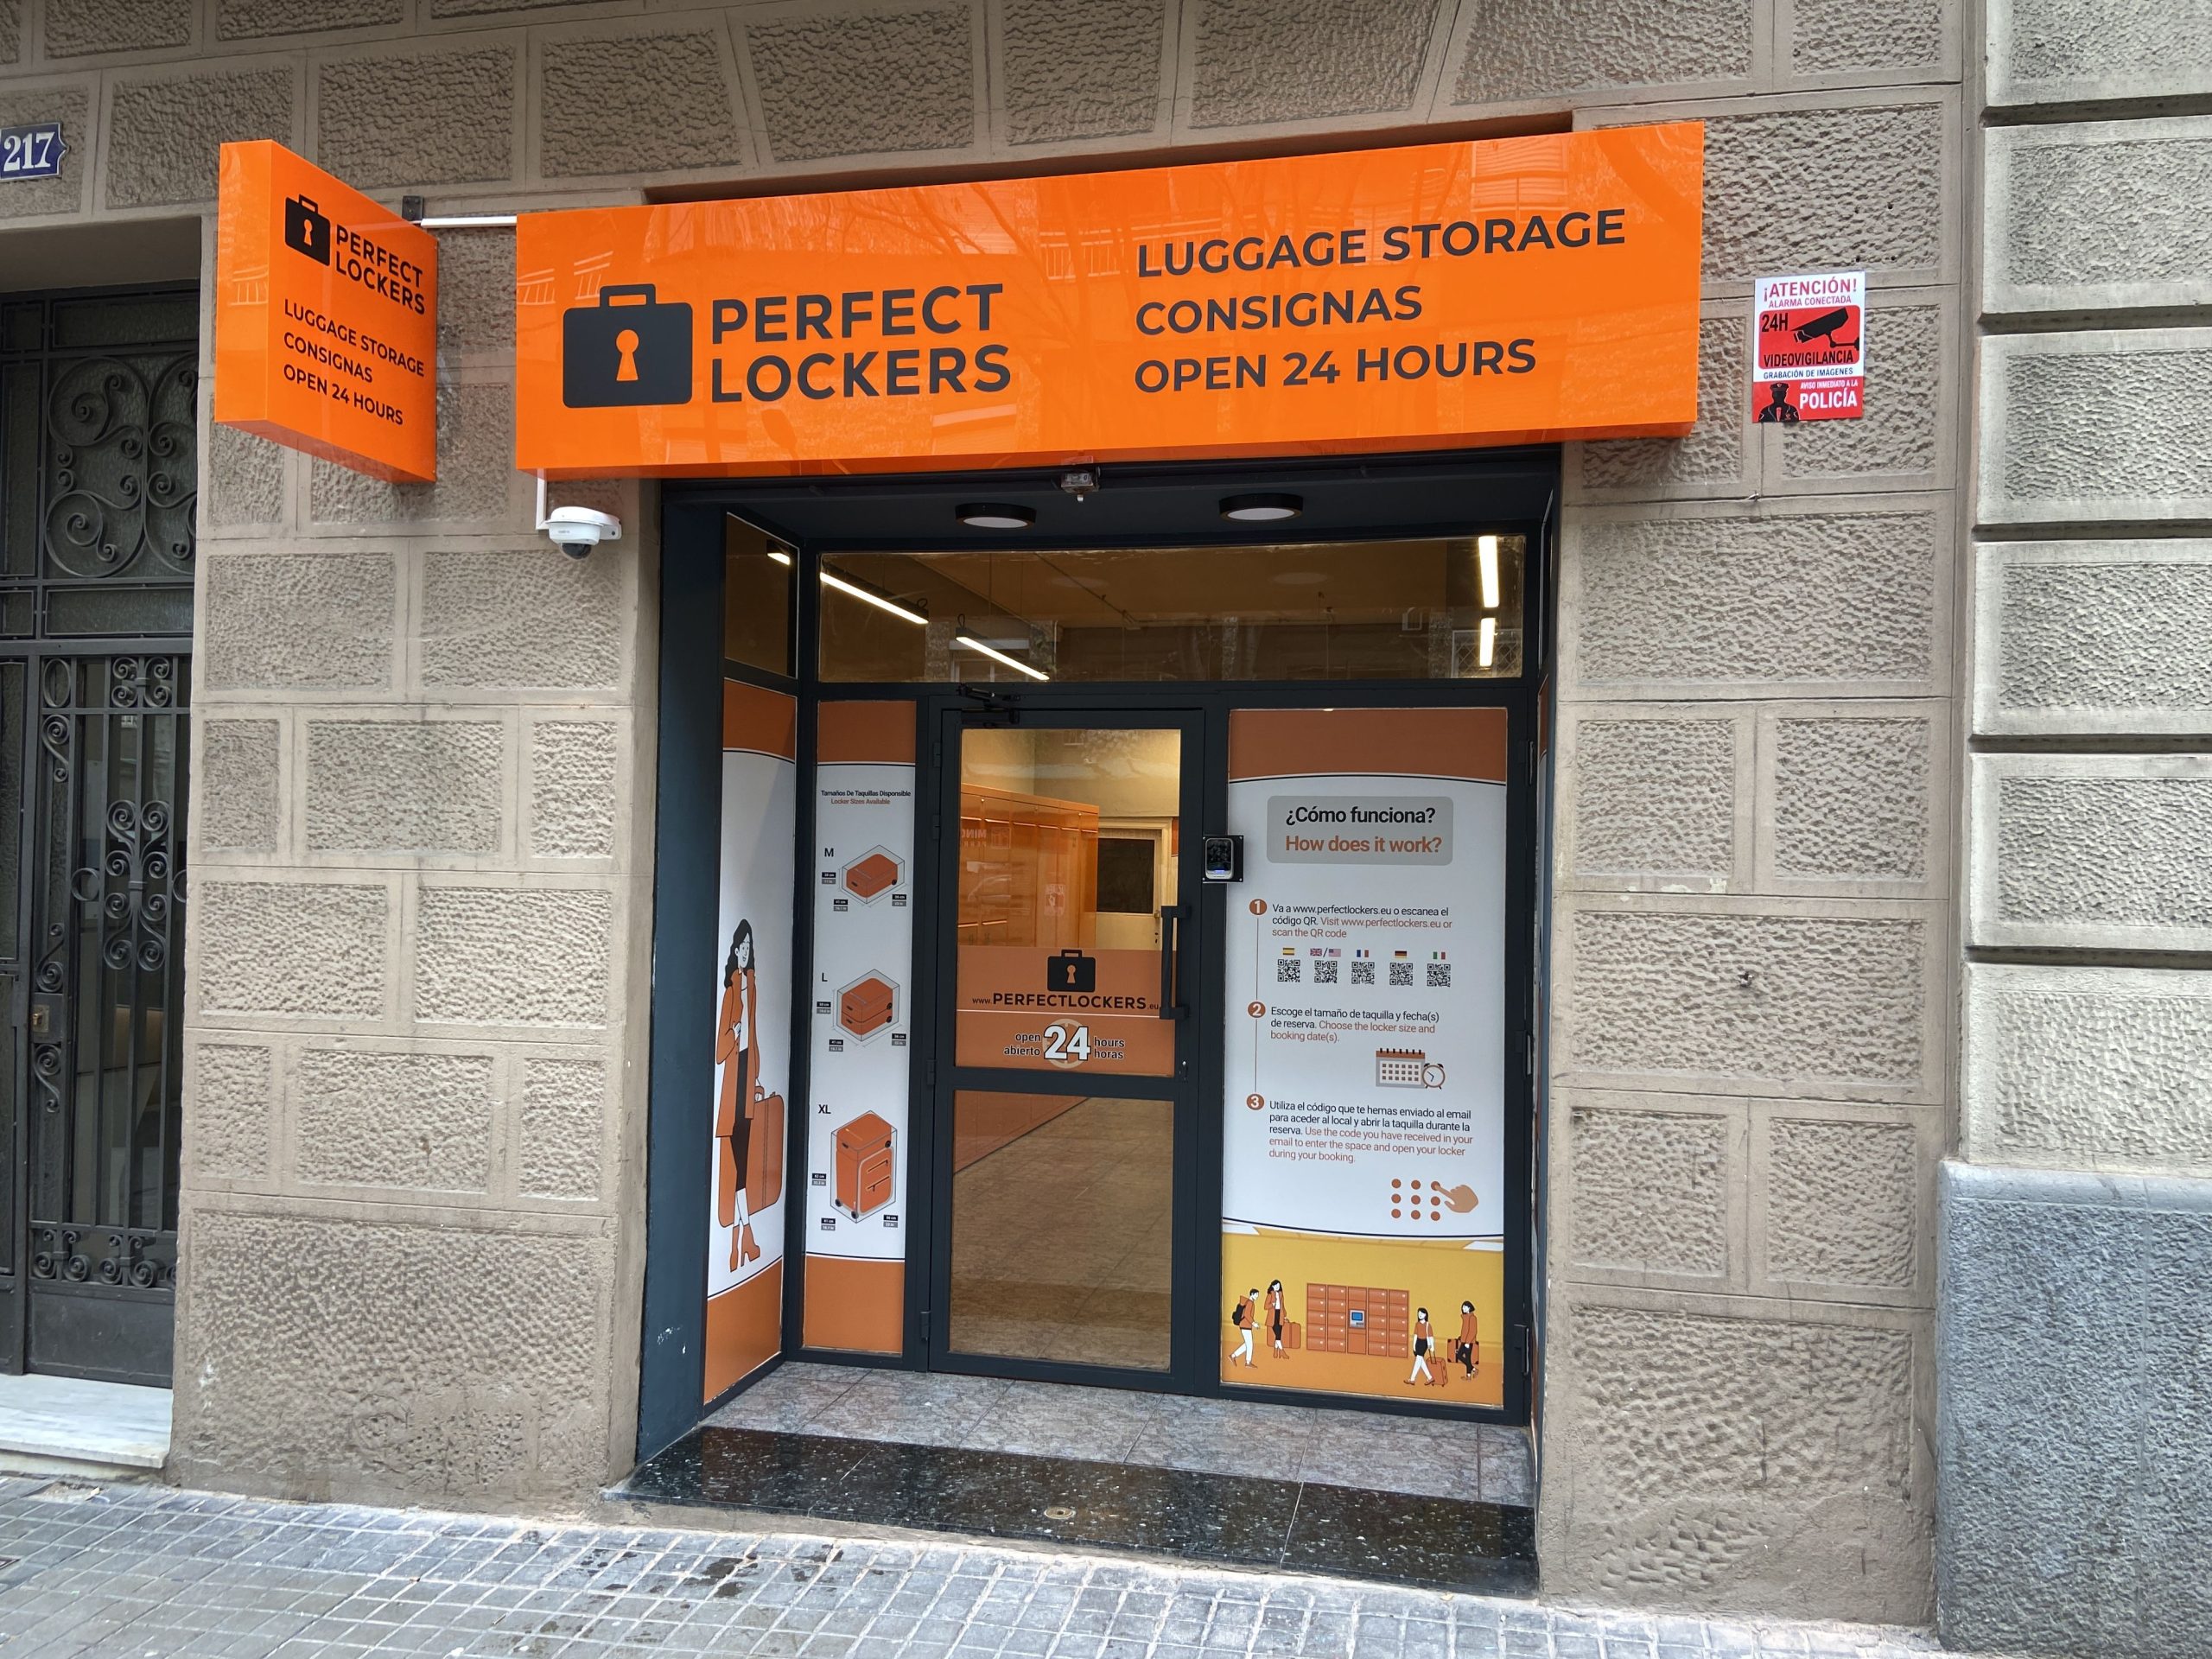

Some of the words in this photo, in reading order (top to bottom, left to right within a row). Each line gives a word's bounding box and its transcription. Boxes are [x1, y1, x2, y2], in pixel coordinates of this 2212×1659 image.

[3, 131, 55, 172] 217
[1138, 229, 1367, 277] LUGGAGE
[1382, 208, 1626, 262] STORAGE
[336, 224, 423, 288] PERFECT
[336, 251, 425, 315] LOCKERS
[1764, 276, 1857, 302] ¡ATENCIÓN!
[1135, 285, 1423, 335] CONSIGNAS
[1769, 300, 1802, 308] ALARMA
[1804, 296, 1852, 306] CONECTADA
[713, 283, 1003, 345] PERFECT
[1761, 312, 1789, 333] 24H
[284, 298, 357, 346] LUGGAGE
[360, 335, 425, 377] STORAGE
[283, 332, 372, 383] CONSIGNAS
[1135, 354, 1267, 393] OPEN
[1283, 350, 1341, 386] 24
[1357, 339, 1537, 383] HOURS
[1764, 350, 1853, 367] VIDEOVIGILANCIA
[712, 344, 1011, 403] LOCKERS
[1764, 370, 1803, 379] GRABACIÓN
[1817, 367, 1853, 377] IMÁGENES
[1800, 381, 1815, 390] AVISO
[1817, 380, 1845, 389] INMEDIATO
[283, 364, 327, 395] OPEN
[332, 383, 350, 404] 24
[353, 392, 404, 425] HOURS
[1800, 388, 1857, 410] POLICÍA
[1286, 806, 1347, 826] ¿Cómo
[1351, 806, 1436, 823] funciona?
[824, 848, 834, 857] M
[1286, 836, 1325, 851] How
[1328, 836, 1370, 852] does
[1375, 836, 1385, 852] it
[1389, 836, 1442, 854] work?
[1255, 899, 1262, 913] 1
[1272, 904, 1284, 912] Va
[1293, 905, 1392, 915] www.perfectlockers.eu
[1440, 906, 1449, 916] el
[1272, 915, 1302, 927] código
[1303, 916, 1319, 926] QR.
[1320, 917, 1340, 926] Visit
[1341, 918, 1440, 928] www.perfectlockers.eu
[1294, 928, 1308, 937] the
[1310, 929, 1324, 938] QR
[1325, 929, 1347, 938] code
[822, 972, 828, 982] L
[1252, 1003, 1262, 1016] 2
[1271, 1007, 1303, 1018] Escoge
[1304, 1007, 1313, 1016] el
[1314, 1008, 1348, 1018] tamaño
[1350, 1009, 1361, 1018] de
[1363, 1010, 1394, 1020] taquilla
[1395, 1013, 1401, 1021] y
[1402, 1011, 1440, 1023] fecha(s)
[1271, 1019, 1282, 1027] de
[1283, 1020, 1317, 1029] reserva.
[1319, 1020, 1352, 1030] Choose
[1354, 1021, 1368, 1031] the
[1370, 1022, 1397, 1032] locker
[1398, 1024, 1416, 1033] size
[1418, 1025, 1435, 1033] and
[1015, 1033, 1040, 1043] open
[1044, 1025, 1091, 1061] 24
[1094, 1036, 1125, 1047] hours
[1270, 1030, 1305, 1042] booking
[1306, 1032, 1339, 1044] date(s).
[1004, 1046, 1040, 1055] abierto
[1094, 1048, 1123, 1058] horas
[818, 1104, 831, 1115] XL
[1250, 1096, 1259, 1109] 3
[1269, 1100, 1295, 1110] Utiliza
[1297, 1102, 1305, 1111] el
[1306, 1103, 1337, 1114] código
[1338, 1105, 1355, 1115] que
[1357, 1105, 1365, 1114] te
[1399, 1108, 1434, 1117] enviado
[1436, 1109, 1444, 1118] al
[1446, 1109, 1471, 1119] email
[1269, 1114, 1288, 1123] para
[1290, 1114, 1320, 1123] aceder
[1321, 1115, 1329, 1124] al
[1332, 1116, 1352, 1125] local
[1354, 1118, 1359, 1128] y
[1361, 1117, 1381, 1127] abrir
[1382, 1118, 1390, 1128] la
[1392, 1120, 1424, 1130] taquilla
[1426, 1121, 1460, 1131] durante
[1462, 1122, 1471, 1131] la
[1269, 1126, 1303, 1135] reserva.
[1305, 1126, 1322, 1135] Use
[1324, 1127, 1338, 1136] the
[1339, 1128, 1362, 1138] code
[1363, 1131, 1379, 1140] you
[1381, 1130, 1402, 1140] have
[1404, 1133, 1441, 1142] received
[1443, 1134, 1452, 1142] in
[1453, 1135, 1473, 1146] your
[1269, 1137, 1293, 1146] email
[1294, 1138, 1304, 1147] to
[1329, 1140, 1343, 1149] the
[1344, 1142, 1372, 1152] space
[1373, 1143, 1390, 1152] and
[1392, 1145, 1414, 1155] open
[1417, 1147, 1436, 1156] your
[1438, 1146, 1465, 1156] locker
[1269, 1148, 1296, 1160] during
[1298, 1151, 1318, 1160] your
[1319, 1152, 1356, 1164] booking.
